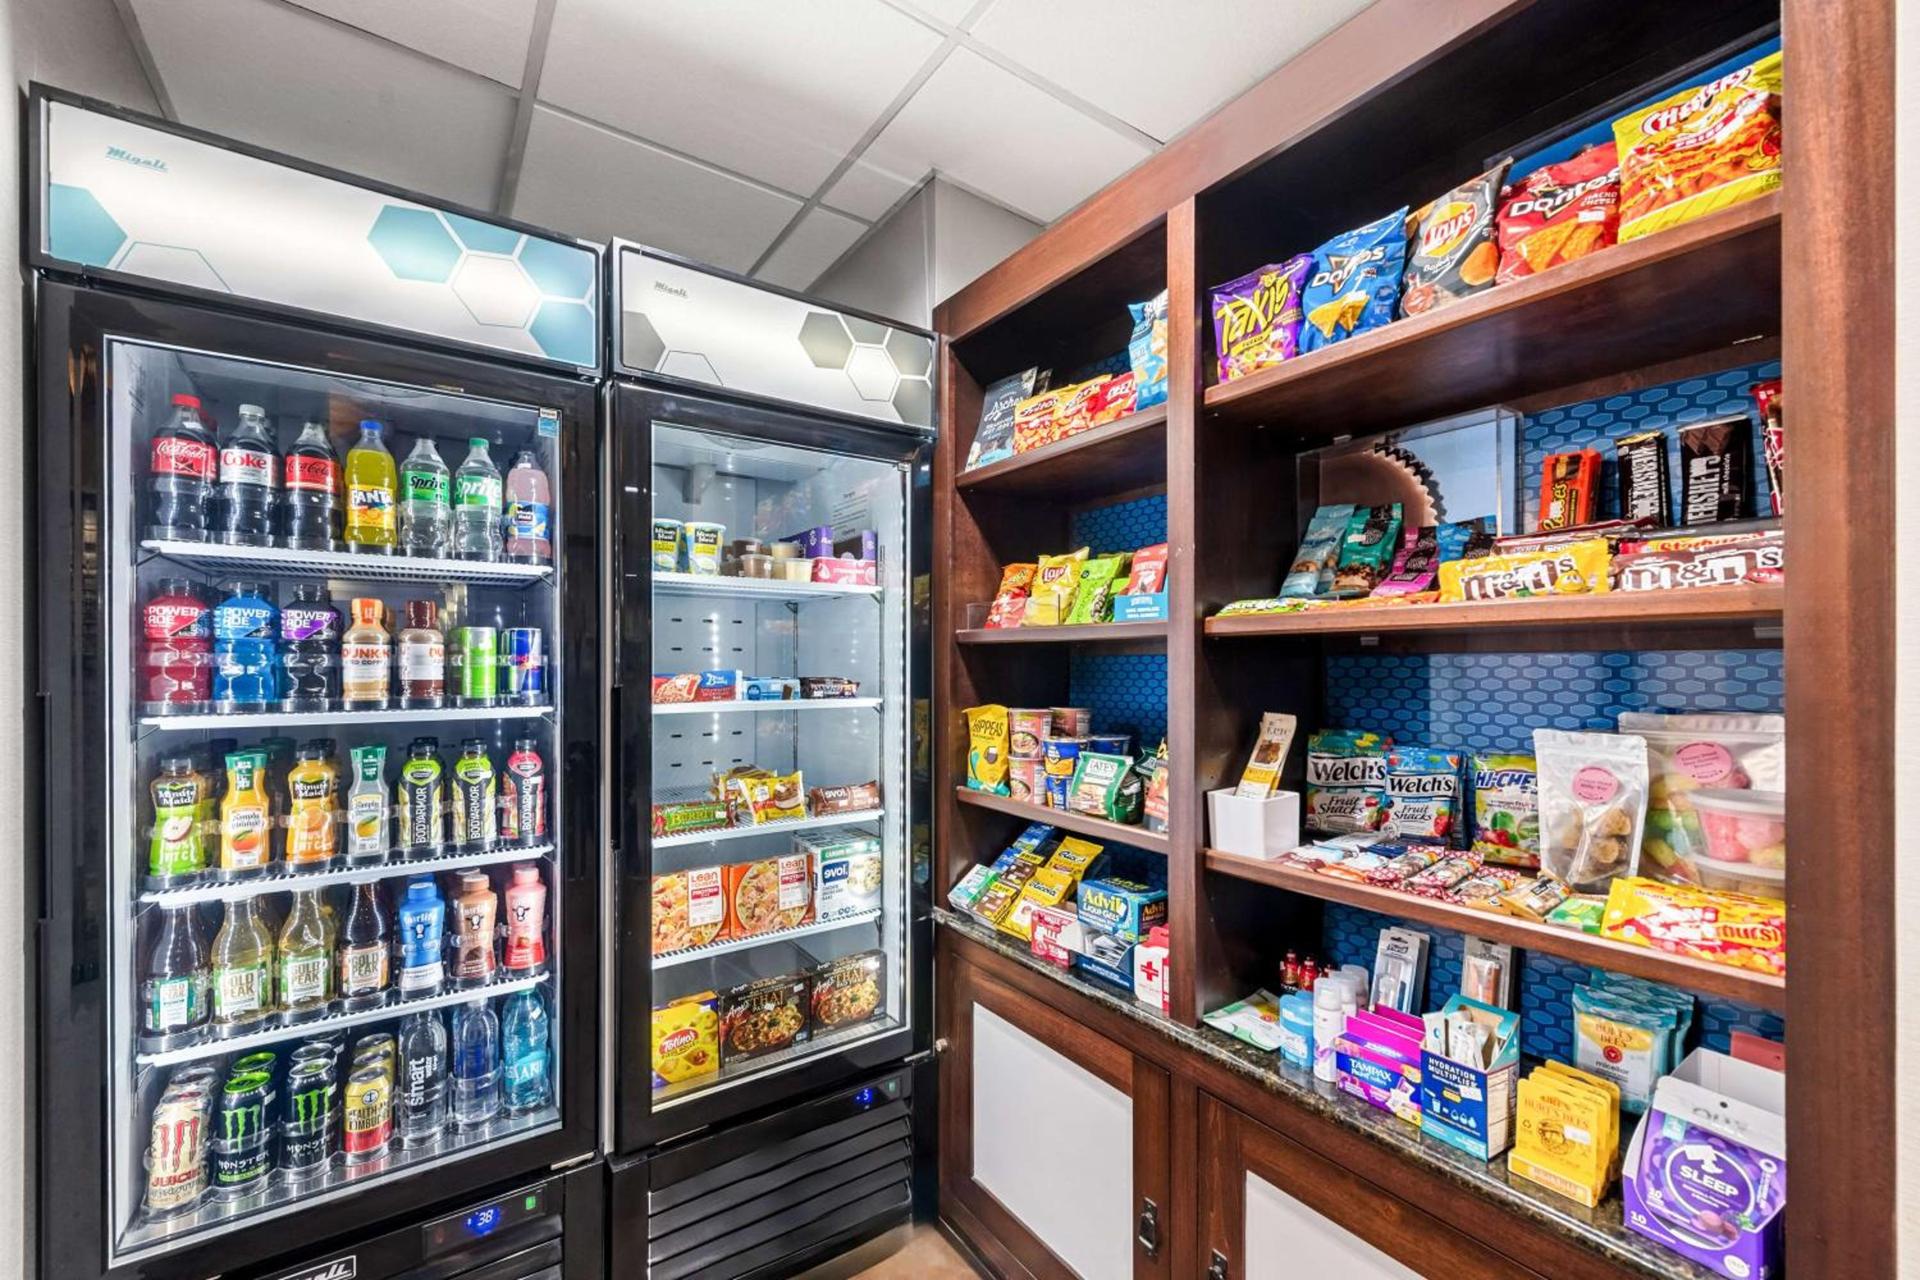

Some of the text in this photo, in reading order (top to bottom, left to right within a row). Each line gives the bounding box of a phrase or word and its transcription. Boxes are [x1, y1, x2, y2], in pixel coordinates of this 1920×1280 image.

[105, 146, 168, 173] Migali
[1510, 167, 1620, 217] Doritos
[222, 451, 267, 471] Coke
[408, 475, 446, 494] Sprite
[456, 475, 501, 498] Sprite
[148, 605, 199, 617] POWER
[223, 606, 270, 618] POWER
[286, 610, 331, 622] POWER
[1311, 760, 1386, 782] Welch's
[1389, 776, 1453, 793] Welch's
[1318, 802, 1363, 815] Snacks
[1329, 795, 1360, 806] Fruit
[1401, 804, 1429, 815] Fruit
[1393, 810, 1432, 821] Snacks
[781, 858, 805, 869] Lean
[691, 871, 719, 883] Lean
[1085, 889, 1126, 917] Advil
[1350, 1058, 1391, 1083] TAMPAX
[1428, 1057, 1476, 1082] HYDRATION
[409, 1057, 425, 1107] smart
[1679, 1164, 1739, 1199] SLEEP
[477, 1209, 493, 1227] 38
